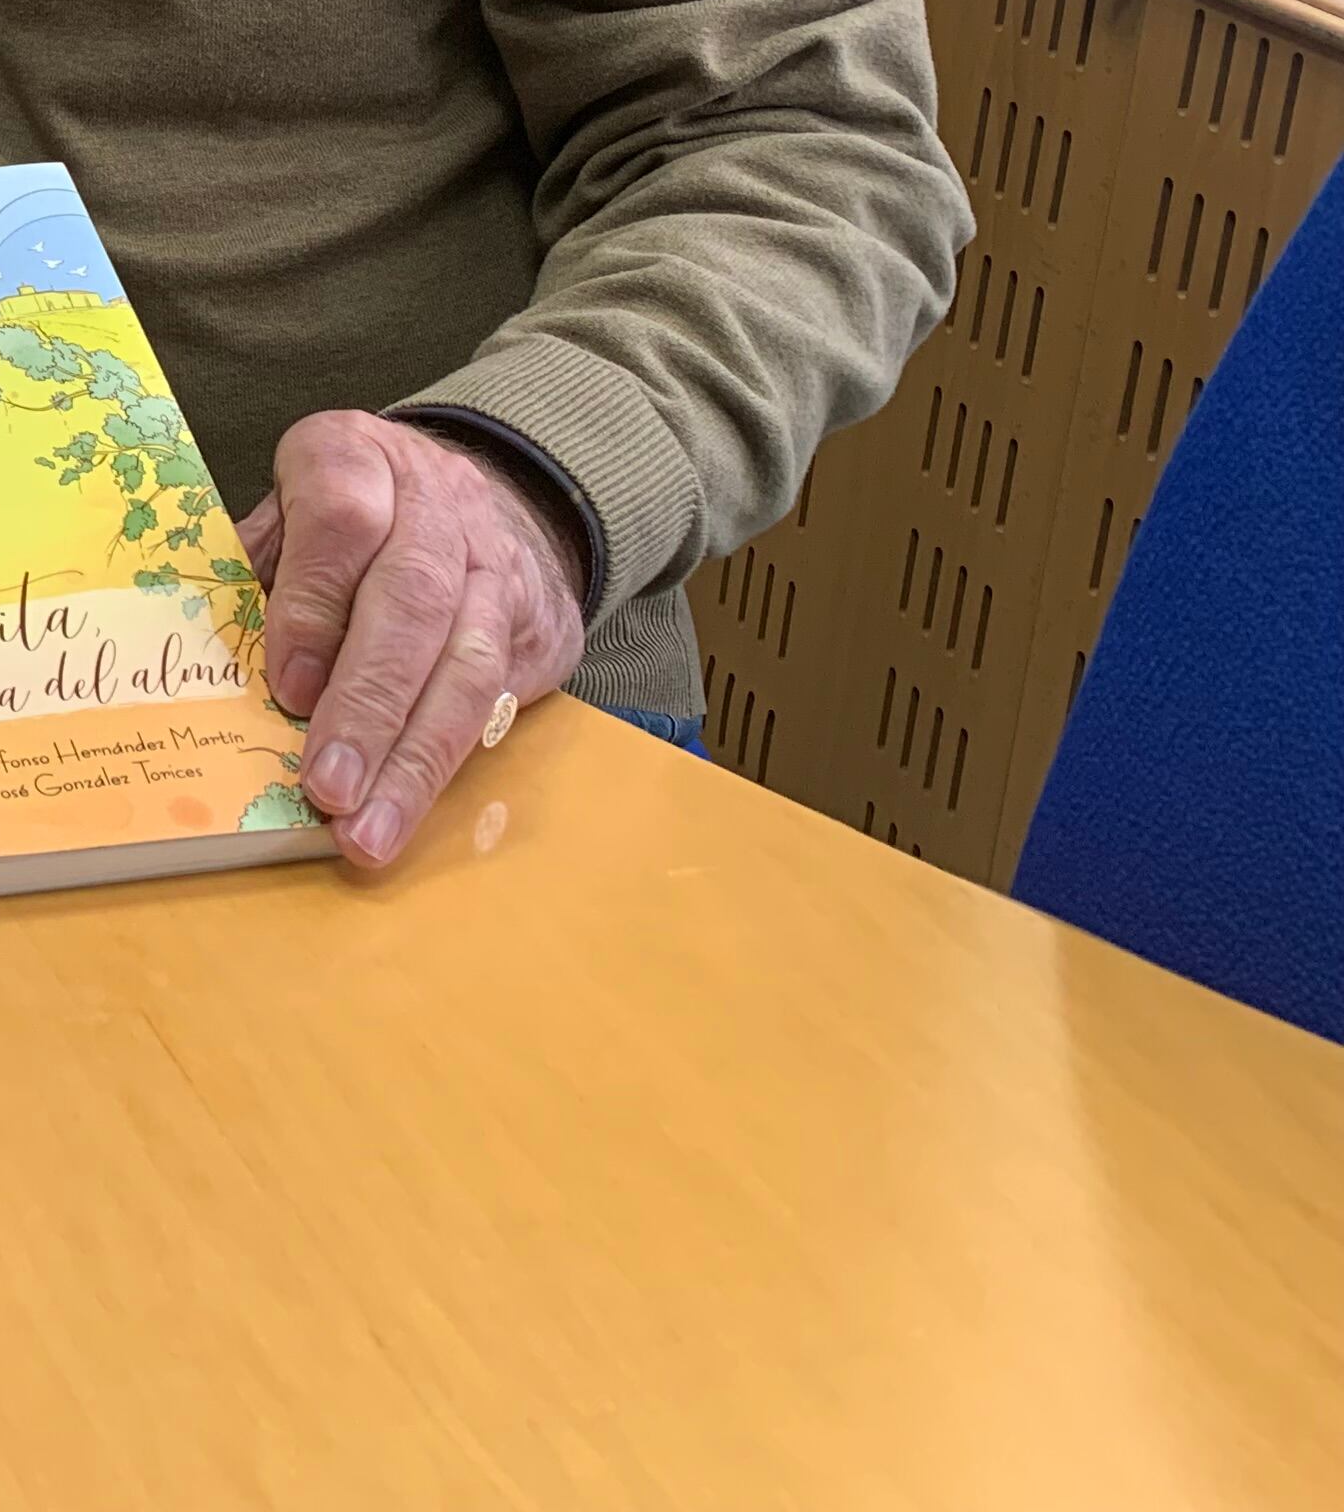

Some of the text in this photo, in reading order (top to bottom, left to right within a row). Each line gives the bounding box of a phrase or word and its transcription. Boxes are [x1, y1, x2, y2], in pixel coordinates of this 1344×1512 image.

[44, 638, 119, 705] del
[131, 632, 254, 697] alma
[53, 731, 167, 765] Hernández
[168, 725, 245, 751] Martín
[33, 766, 130, 797] González
[131, 759, 204, 785] Torices
